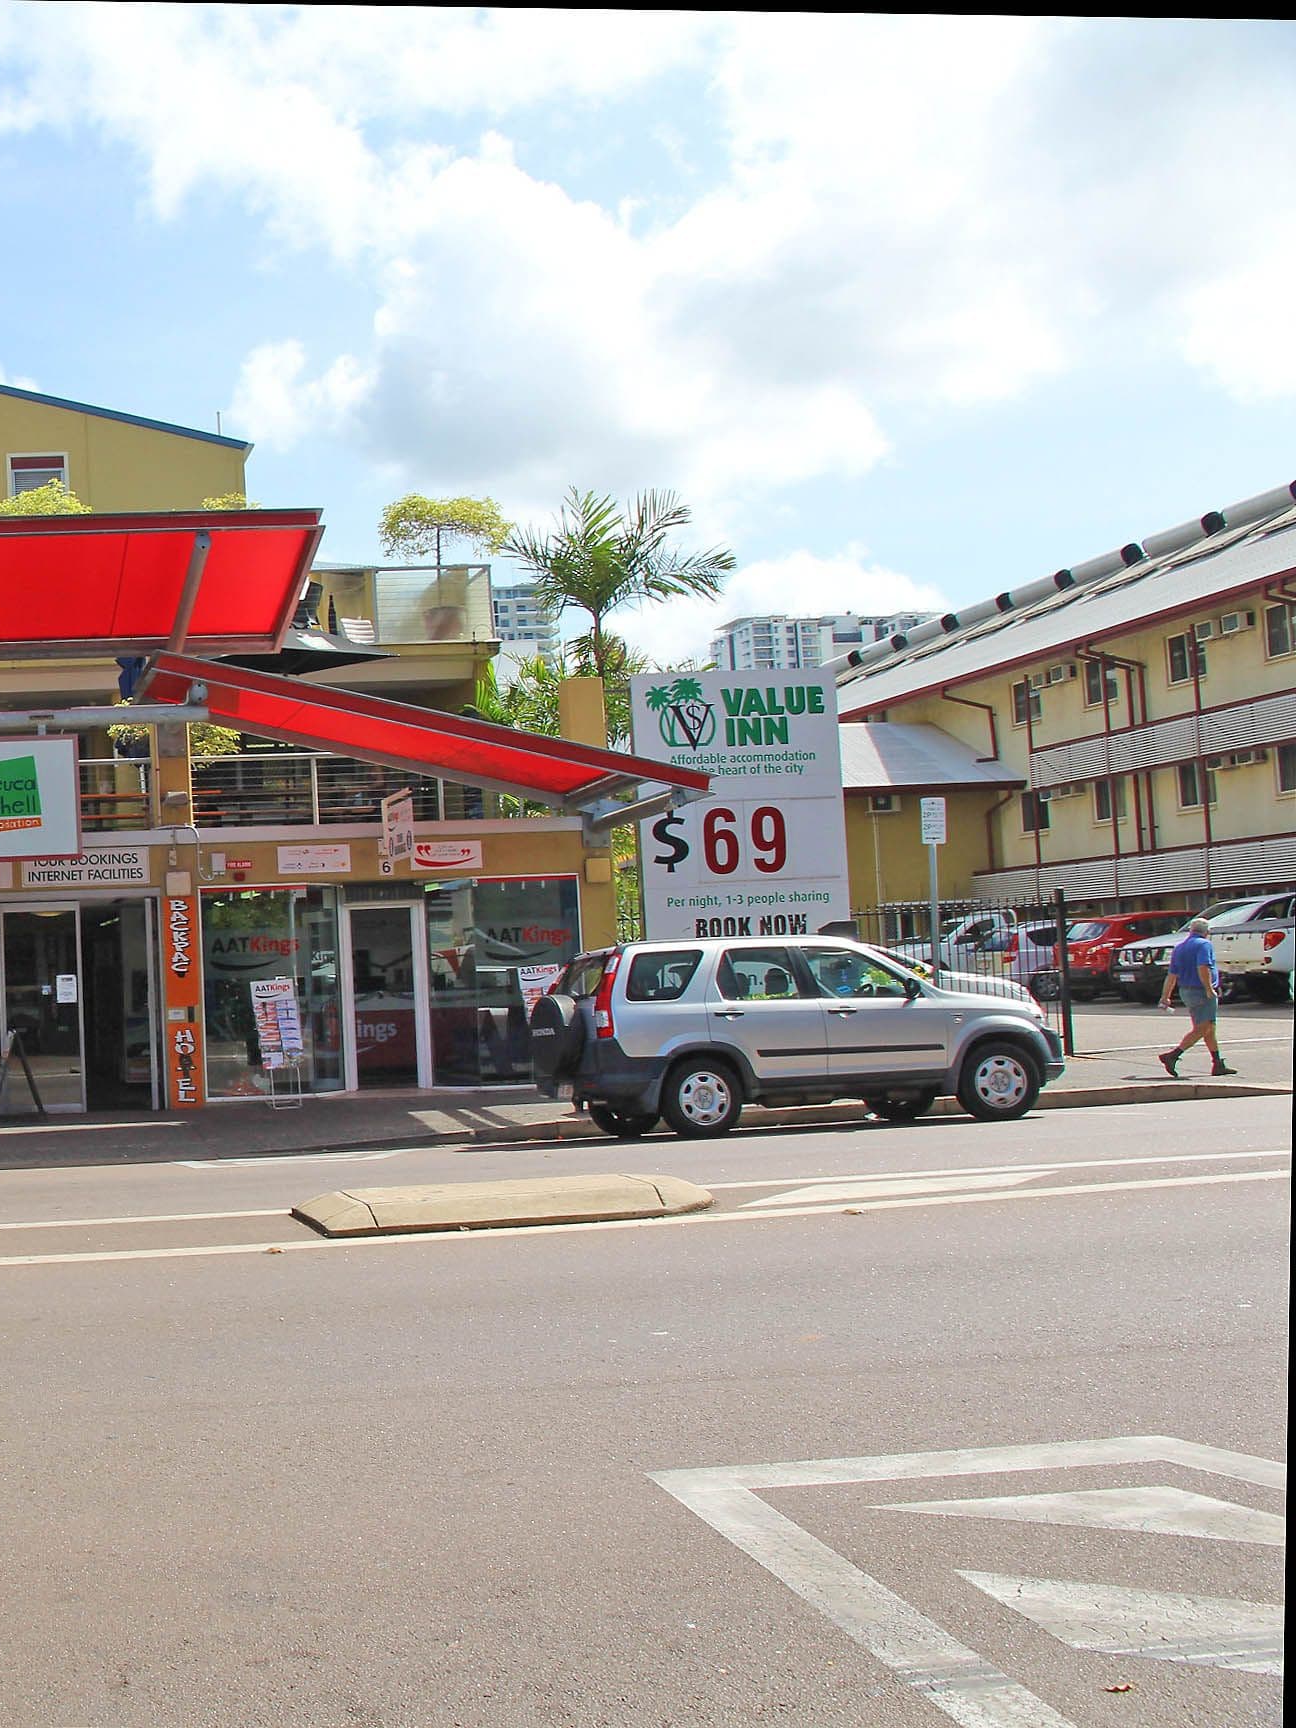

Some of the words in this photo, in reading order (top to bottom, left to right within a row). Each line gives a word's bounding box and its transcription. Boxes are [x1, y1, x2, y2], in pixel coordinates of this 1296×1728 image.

[720, 686, 825, 717] VALUE
[725, 716, 789, 747] INN
[670, 753, 727, 766] Affordable
[730, 751, 816, 764] accommodation
[718, 764, 747, 776] heart
[750, 763, 762, 775] of
[764, 762, 781, 774] the
[785, 763, 804, 775] city
[71, 853, 139, 866] BOOKINGS
[382, 861, 391, 873] 6
[28, 870, 83, 882] INTERNET
[88, 868, 143, 880] FACILITIES
[667, 897, 685, 907] Per
[688, 895, 722, 908] night,
[727, 894, 744, 904] 1-3
[747, 892, 785, 905] people
[789, 891, 830, 904] sharing
[696, 917, 752, 938] BOOK
[760, 914, 807, 936] NOW
[487, 925, 572, 946] AATKings
[212, 935, 301, 956] AATKings
[520, 965, 558, 977] AATKings
[255, 984, 291, 994] AATKings
